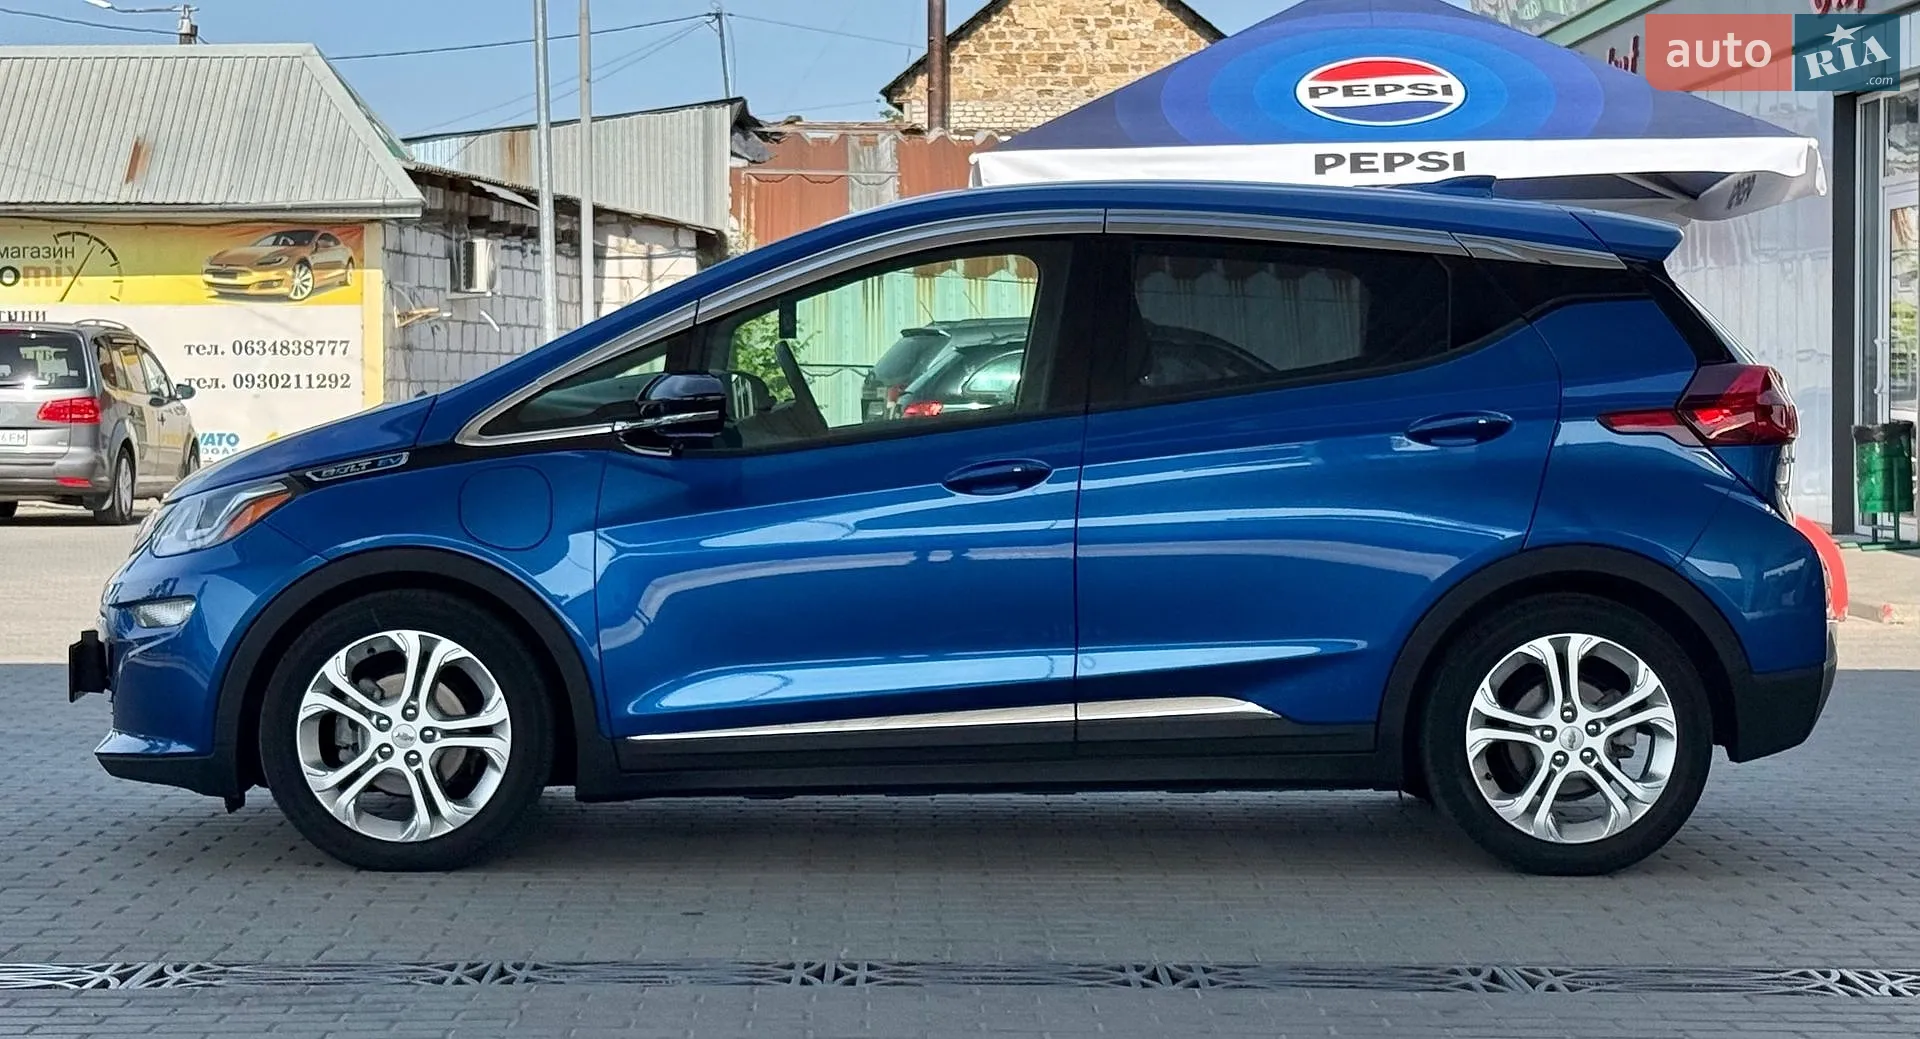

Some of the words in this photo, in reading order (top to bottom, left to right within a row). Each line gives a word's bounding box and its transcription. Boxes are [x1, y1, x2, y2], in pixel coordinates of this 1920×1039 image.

[1308, 83, 1453, 99] PEPSI
[1314, 151, 1466, 175] PEPSI
[184, 343, 226, 356] тел.
[232, 340, 350, 356] 0634838777
[184, 377, 226, 389] тел.
[233, 373, 352, 389] 0930211292
[321, 461, 373, 477] BOLT
[377, 457, 402, 467] EV
